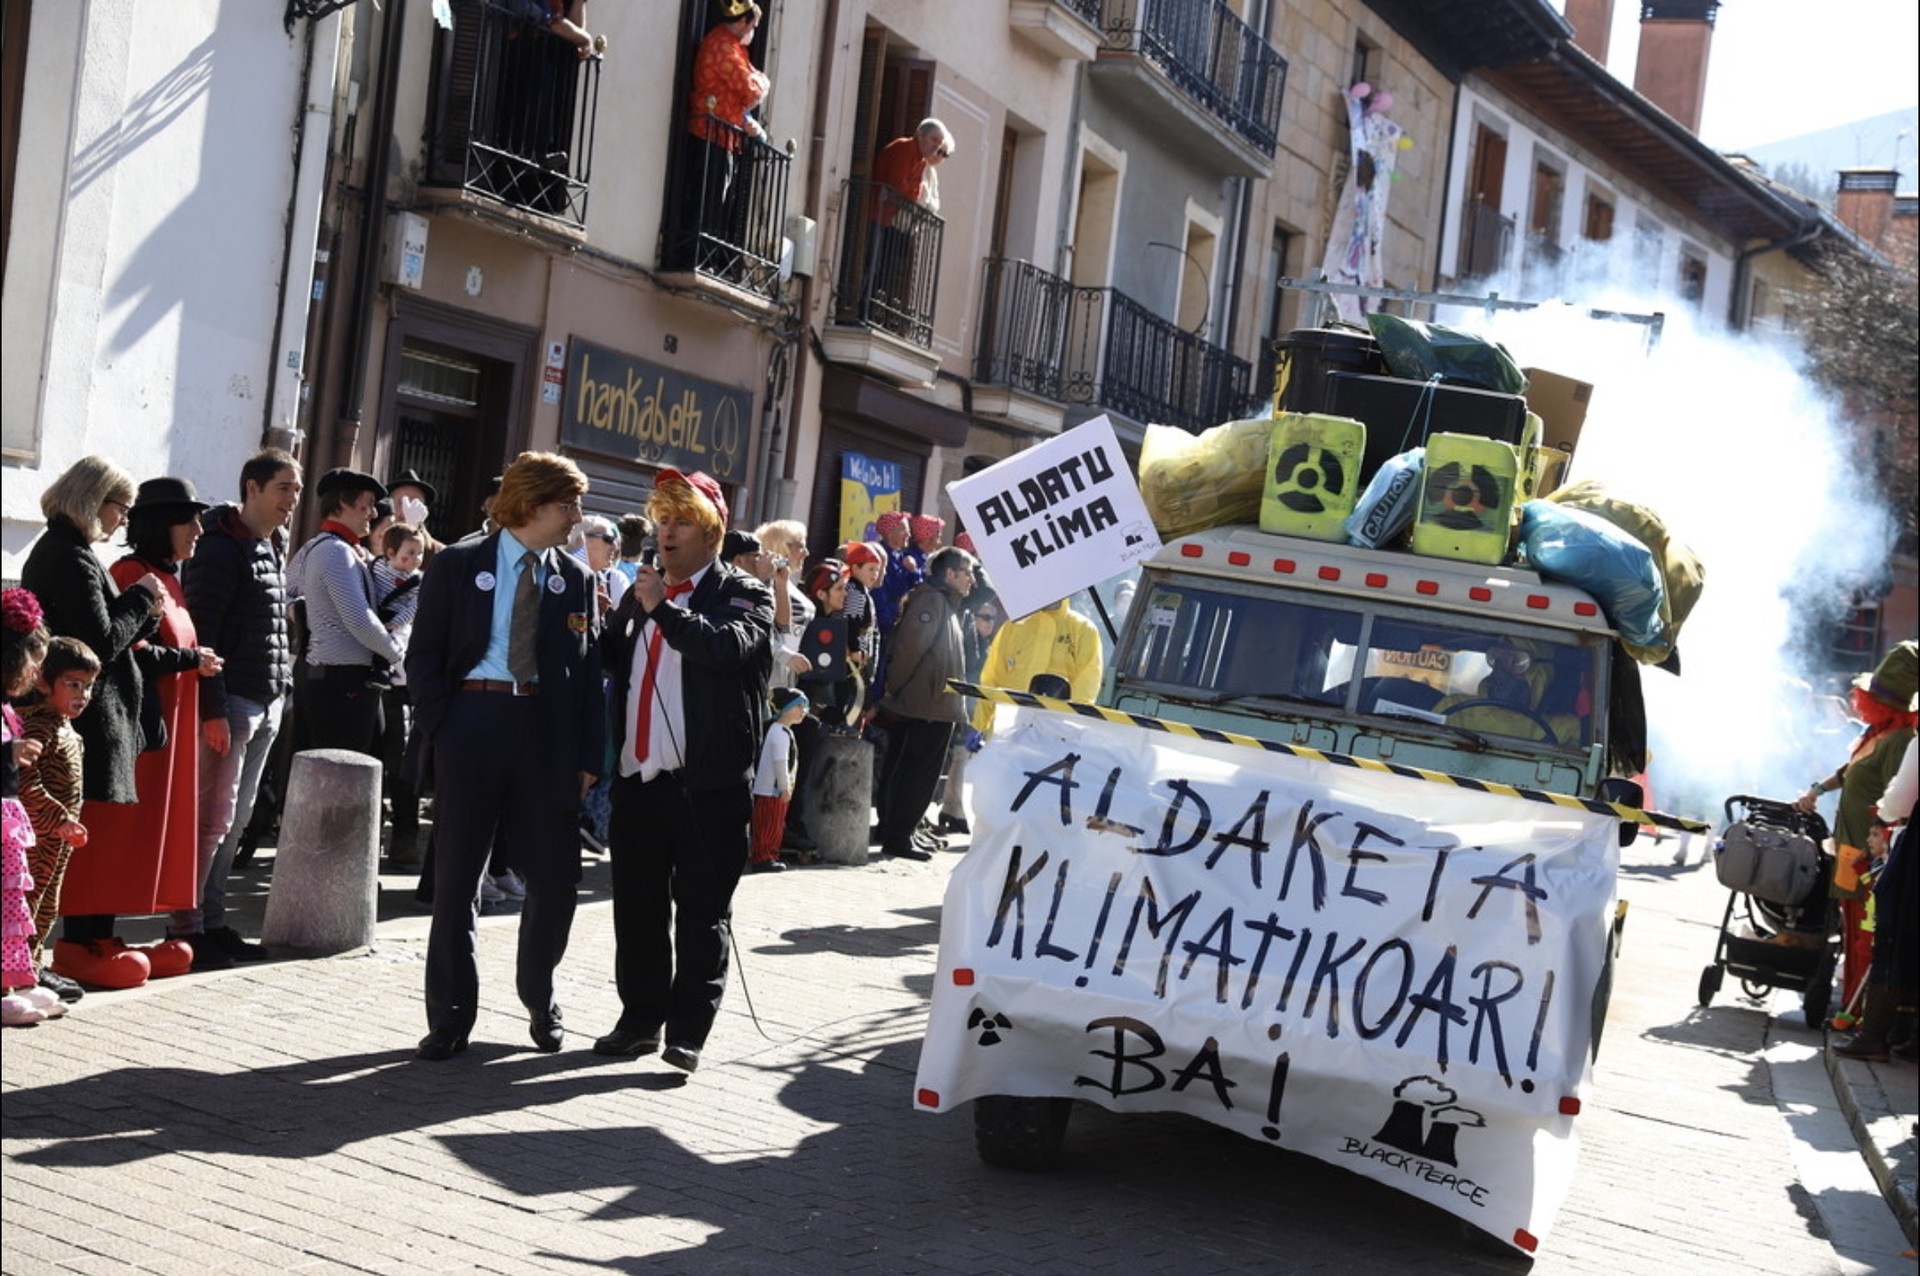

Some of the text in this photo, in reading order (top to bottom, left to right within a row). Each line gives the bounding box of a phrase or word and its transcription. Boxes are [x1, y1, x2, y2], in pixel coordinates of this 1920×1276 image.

[577, 353, 706, 453] hankabeltz
[976, 446, 1114, 536] ALDATU
[1364, 468, 1413, 539] CAUTION
[1010, 752, 1548, 945] ALDAKETA
[1338, 1136, 1490, 1207] BLACK PEACE
